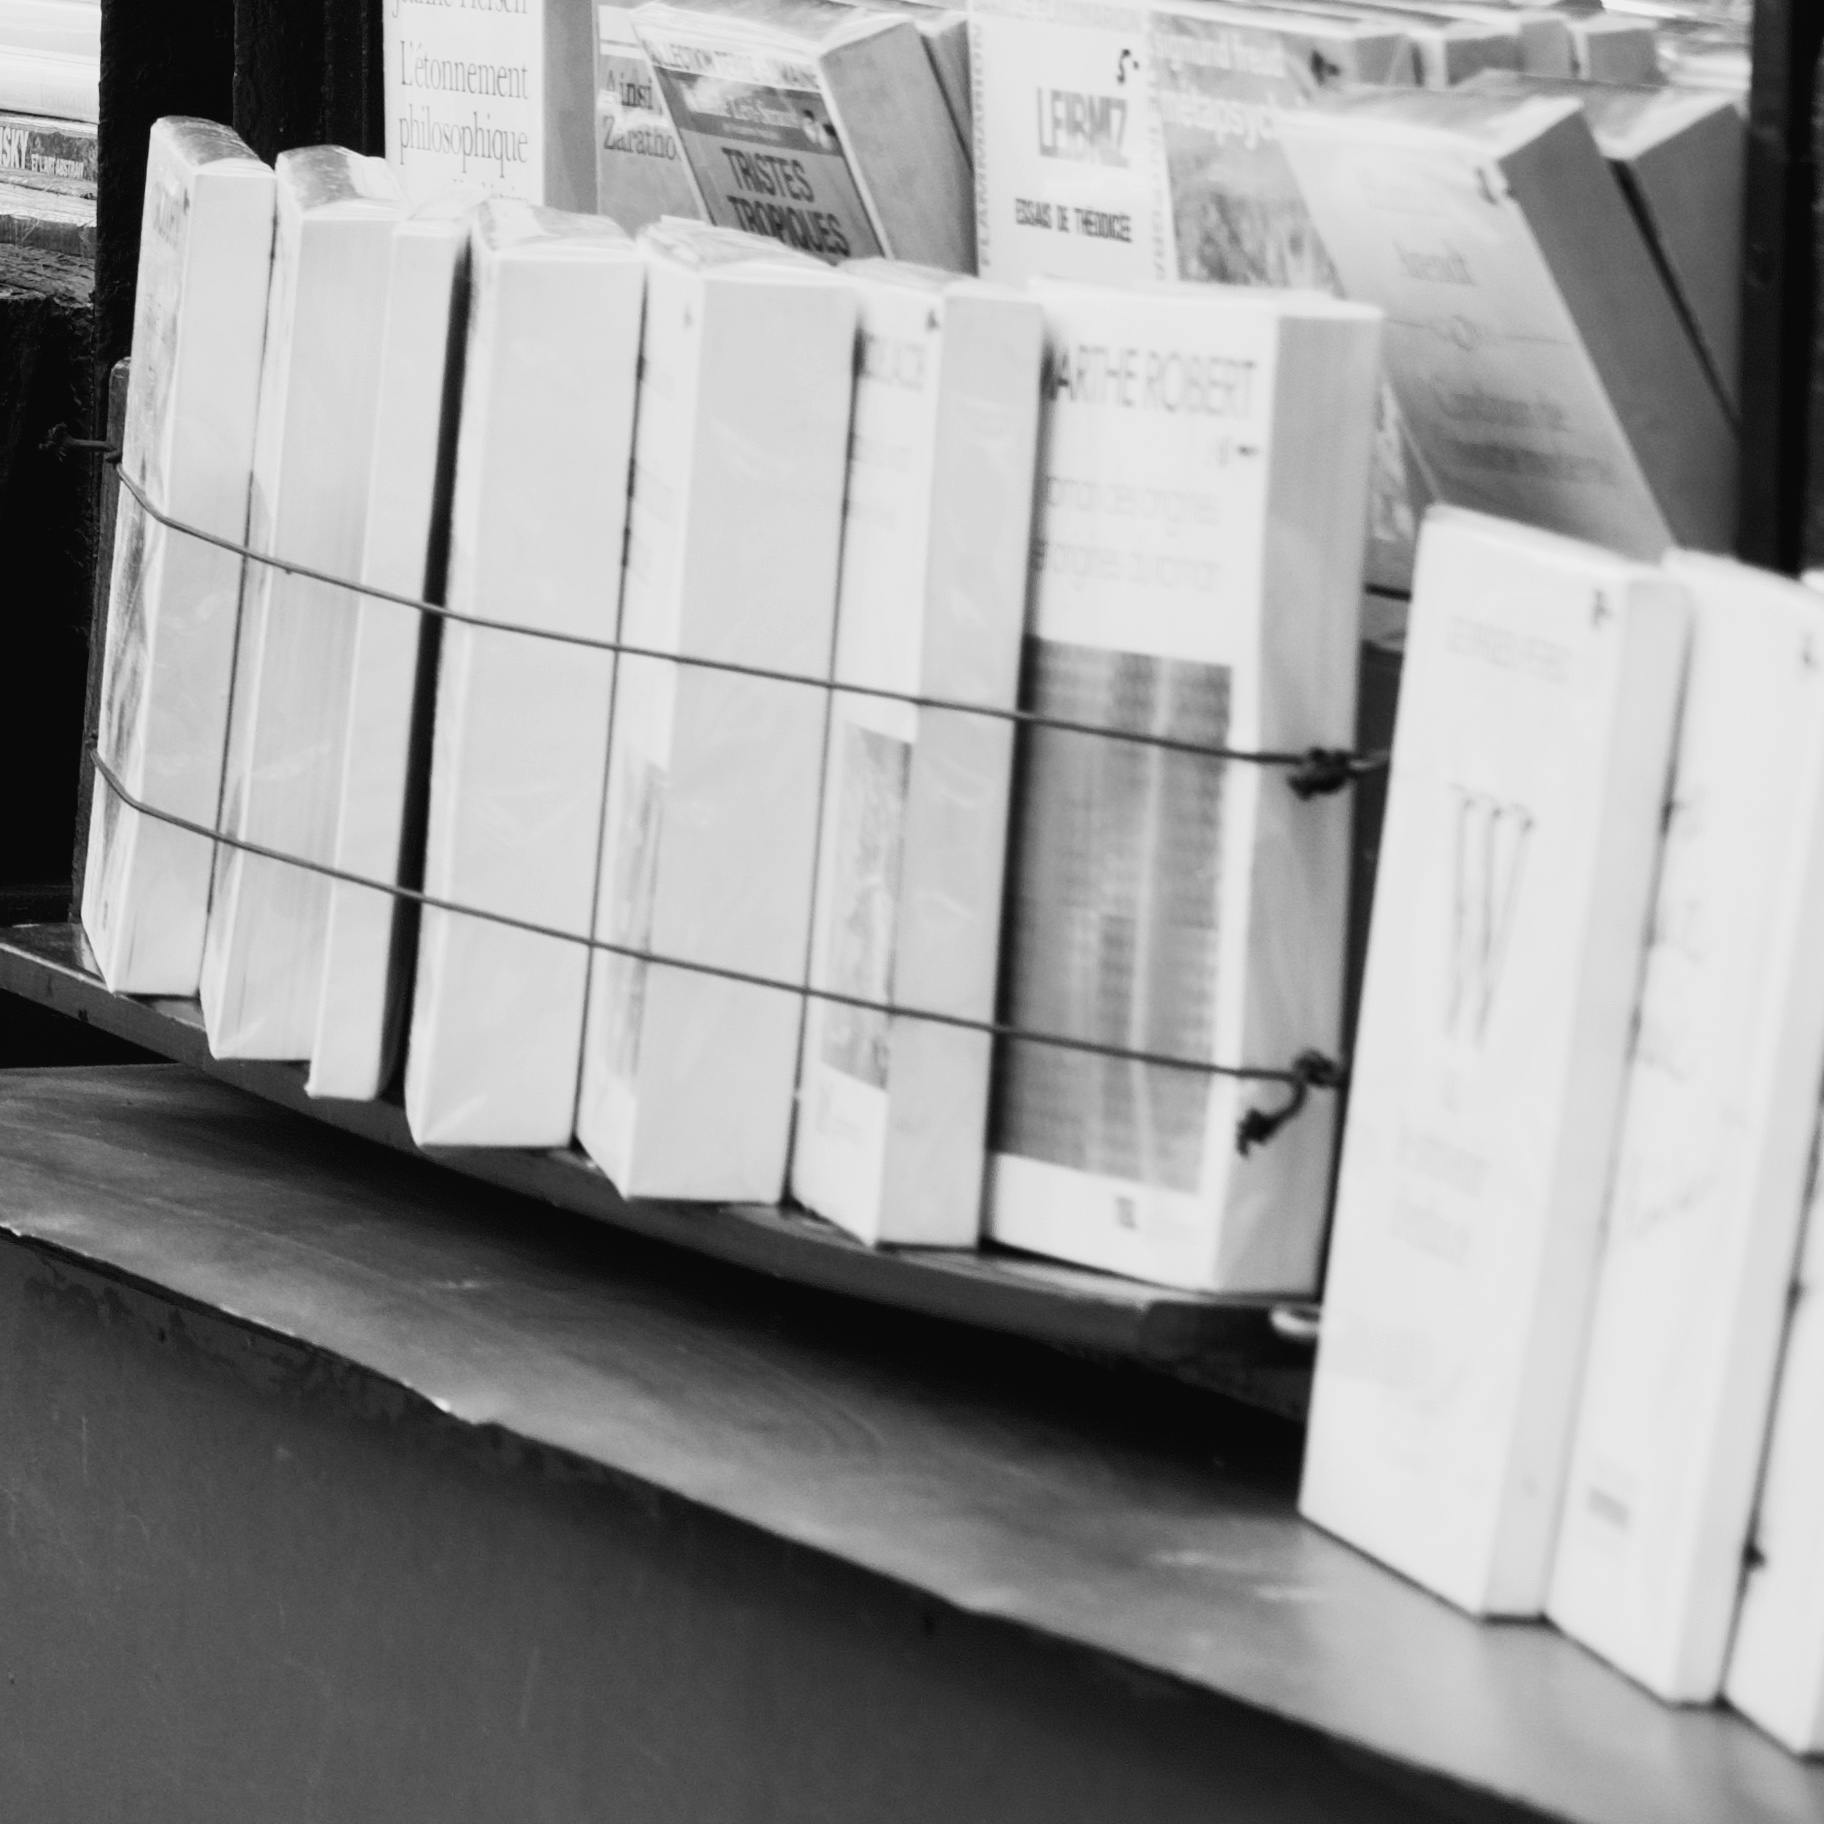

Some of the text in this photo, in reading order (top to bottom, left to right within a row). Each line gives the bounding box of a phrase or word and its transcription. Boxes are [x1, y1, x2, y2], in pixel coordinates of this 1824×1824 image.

[398, 38, 530, 102] L'étonnement
[396, 102, 530, 180] philosophique
[1036, 84, 1130, 170] LEIBNIZ
[720, 145, 816, 204] TRISTES
[725, 193, 853, 258] TROPIQUES
[1014, 197, 1052, 230] ESSAIS
[1055, 204, 1071, 234] DE
[1144, 347, 1258, 420] ROBERT
